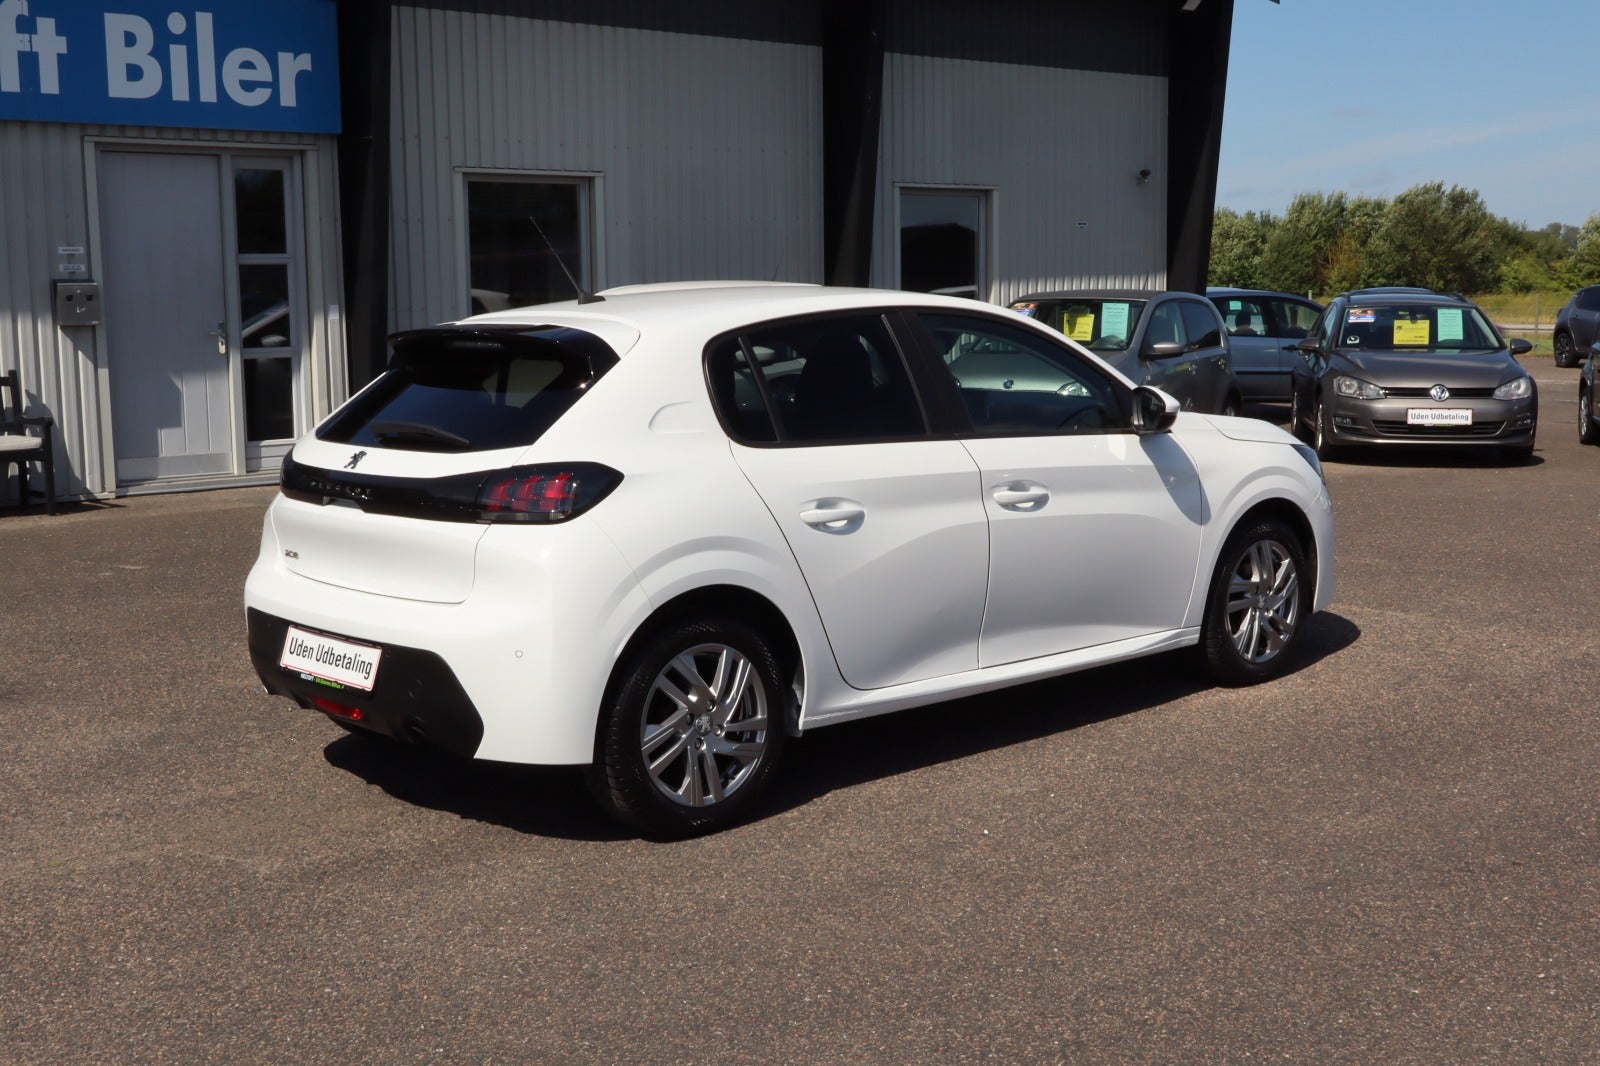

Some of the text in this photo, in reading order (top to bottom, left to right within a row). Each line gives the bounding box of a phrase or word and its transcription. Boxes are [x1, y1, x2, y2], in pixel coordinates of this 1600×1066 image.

[104, 11, 312, 107] Biler
[1410, 412, 1469, 421] Uden Udbetaling
[289, 637, 373, 680] Uden Udbetaling
